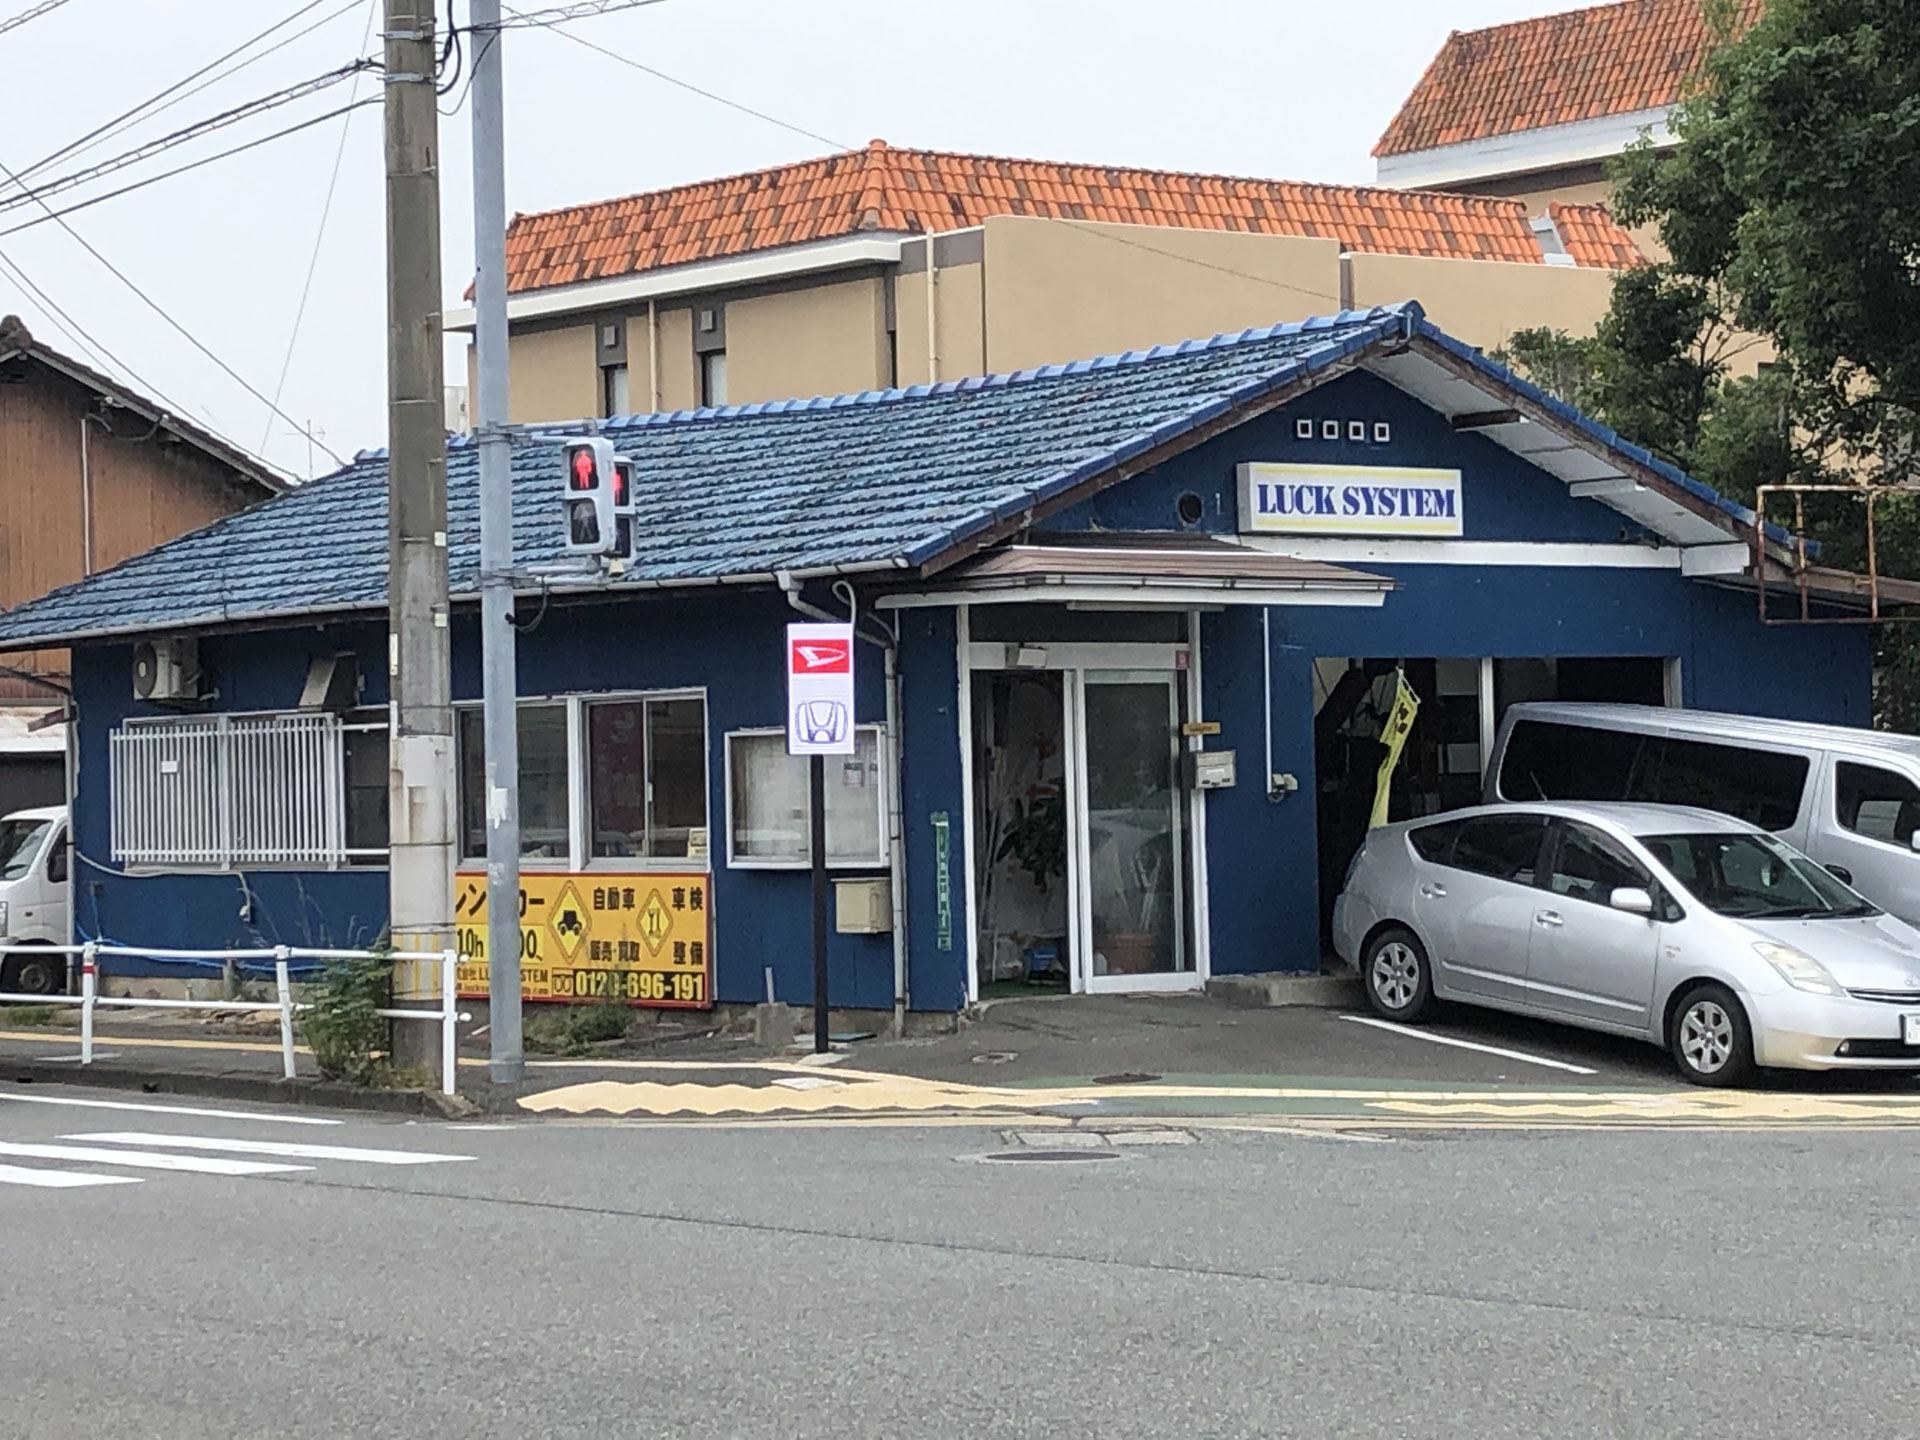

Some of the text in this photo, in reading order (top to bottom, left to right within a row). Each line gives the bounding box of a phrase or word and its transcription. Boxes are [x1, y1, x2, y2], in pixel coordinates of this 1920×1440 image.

[1257, 484, 1456, 517] LUCK SYSTEM
[593, 886, 636, 911] 自動車
[671, 886, 704, 911] 車検
[672, 940, 704, 966] 整備
[575, 970, 704, 1001] 0120-696-191
